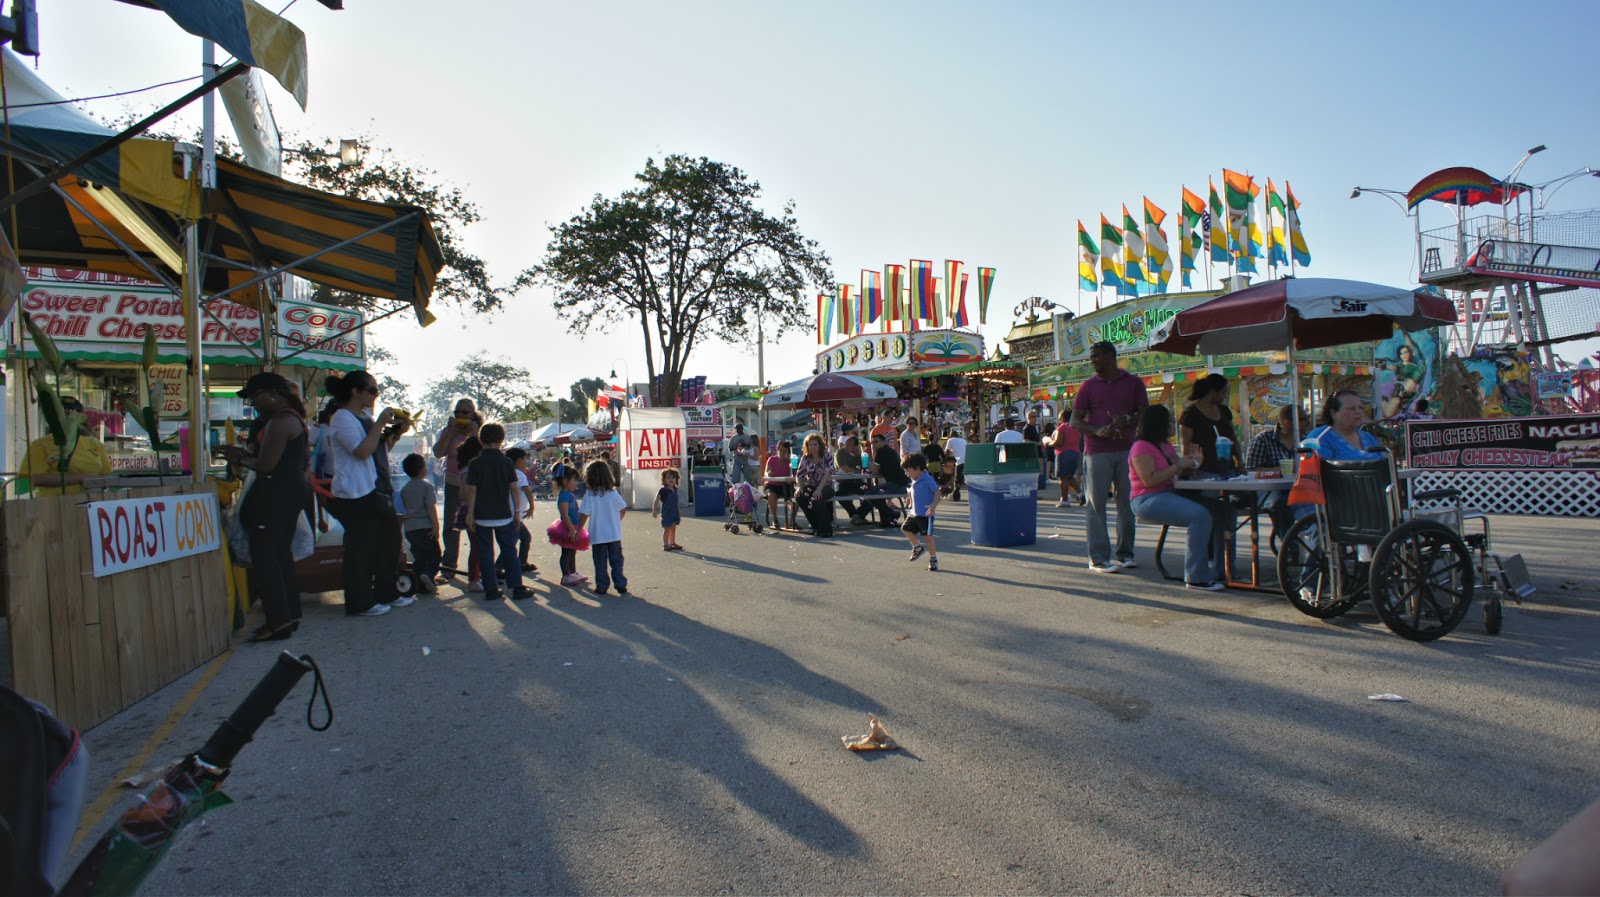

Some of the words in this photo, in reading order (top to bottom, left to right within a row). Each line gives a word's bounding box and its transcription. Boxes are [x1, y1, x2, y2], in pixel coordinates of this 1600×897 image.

[24, 289, 111, 313] Sweet
[202, 299, 259, 320] Fries
[1341, 300, 1368, 312] Fair
[26, 313, 91, 337] Chili
[201, 322, 262, 343] Fries
[284, 307, 357, 331] Cold
[1101, 308, 1185, 343] LEMONAD
[286, 329, 358, 355] Drinks
[149, 367, 183, 379] CHILI
[149, 383, 181, 395] CESE
[638, 428, 681, 457] ATM
[1413, 431, 1442, 447] CHILI
[1443, 426, 1487, 445] CHEESE
[1488, 422, 1522, 441] FRIES
[1528, 422, 1600, 438] NACH
[640, 459, 680, 468] INSIDE
[1413, 449, 1460, 468] PHILLY
[1461, 447, 1573, 468] CHEESESTEAK
[97, 502, 166, 567] ROAST
[174, 498, 215, 551] CORN
